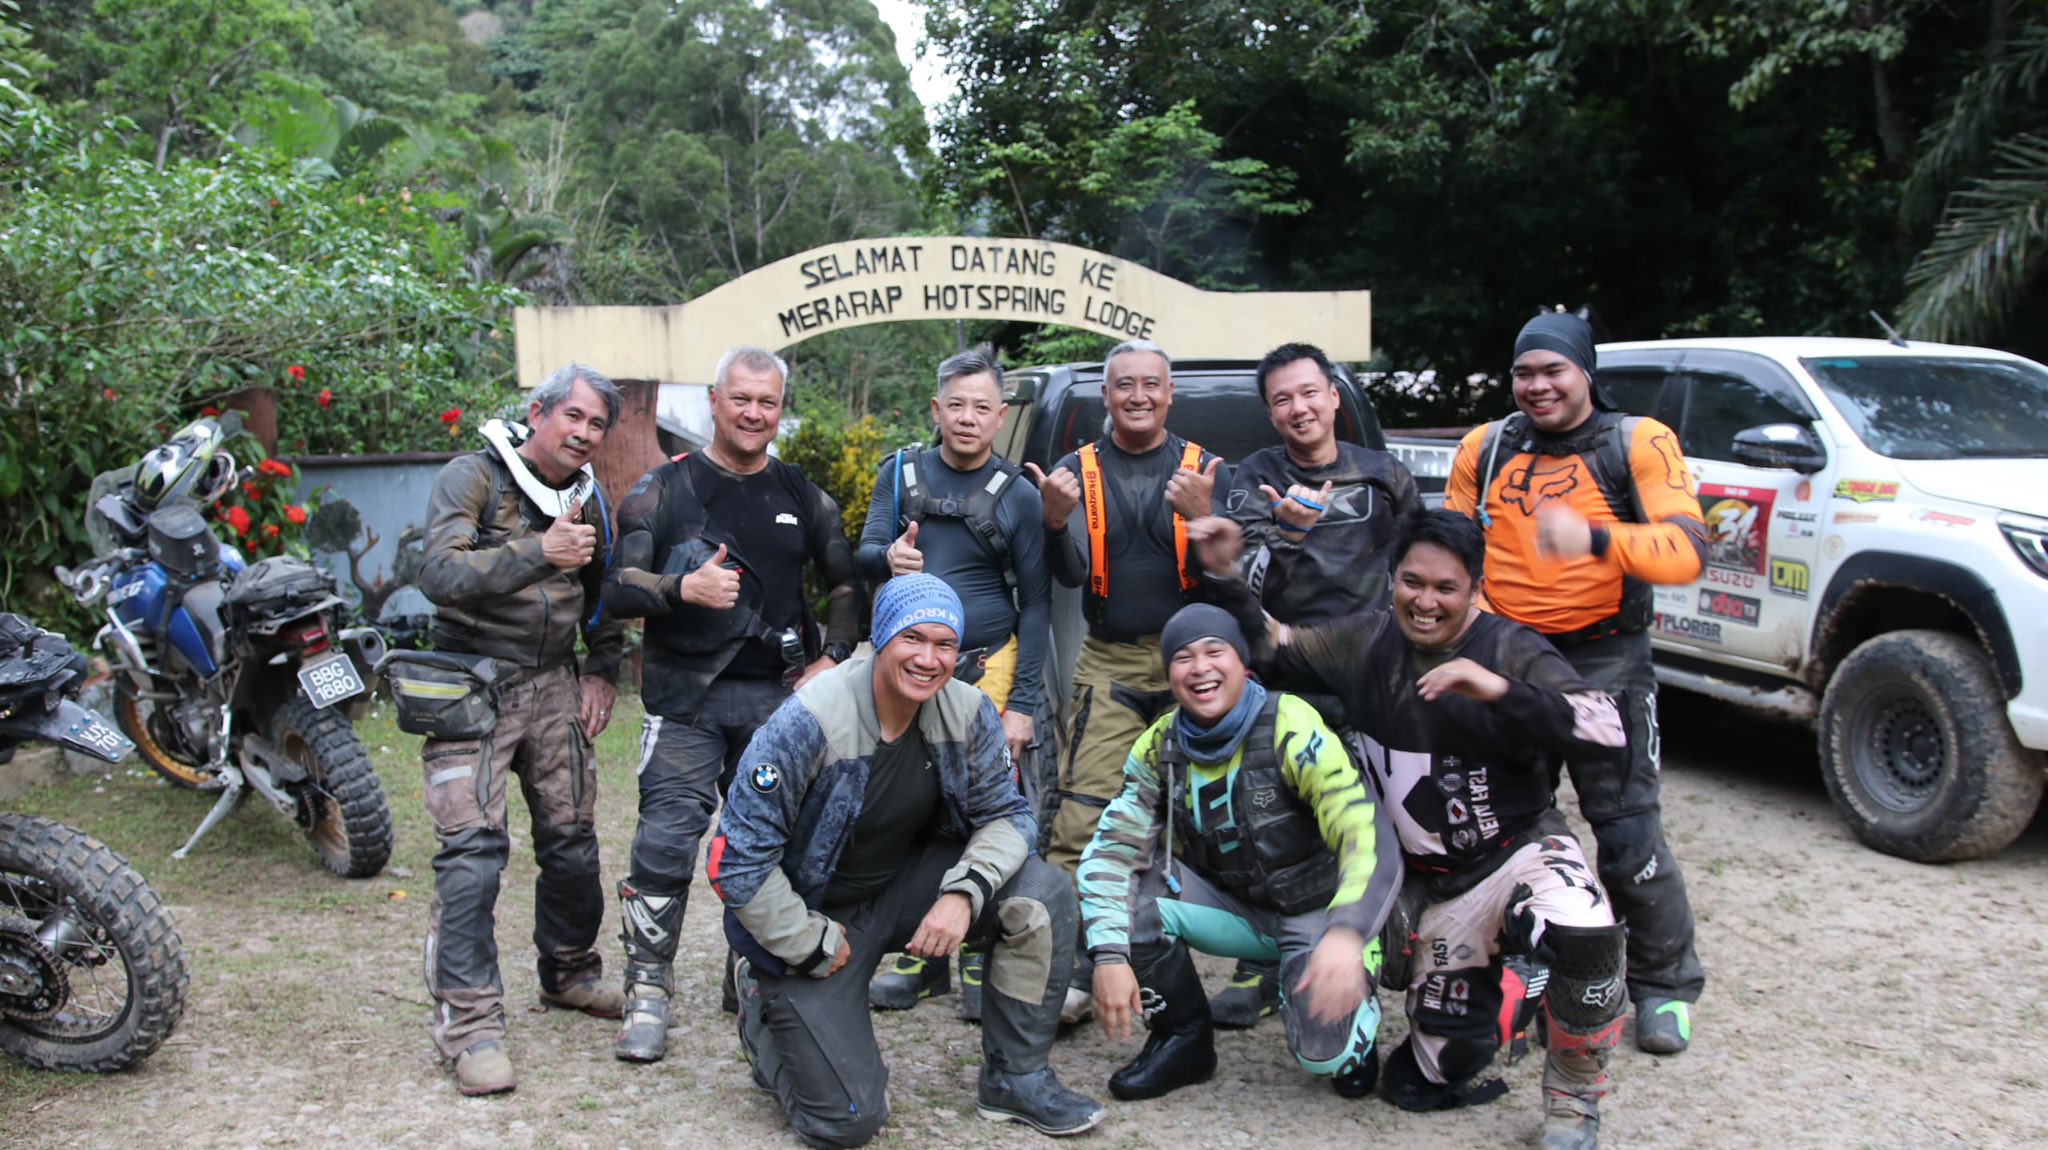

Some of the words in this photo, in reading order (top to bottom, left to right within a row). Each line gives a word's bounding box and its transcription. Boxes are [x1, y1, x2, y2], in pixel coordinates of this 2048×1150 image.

[800, 245, 923, 289] SELAMAT
[951, 245, 1056, 276] DATANG
[1080, 258, 1116, 292] KE
[777, 285, 903, 337] MERARAP
[923, 284, 1065, 315] HOTSPRING
[1084, 296, 1156, 340] LODGE
[309, 662, 344, 687] BBG
[315, 675, 356, 700] 1680
[80, 721, 110, 742] VJX
[95, 730, 123, 751] 701
